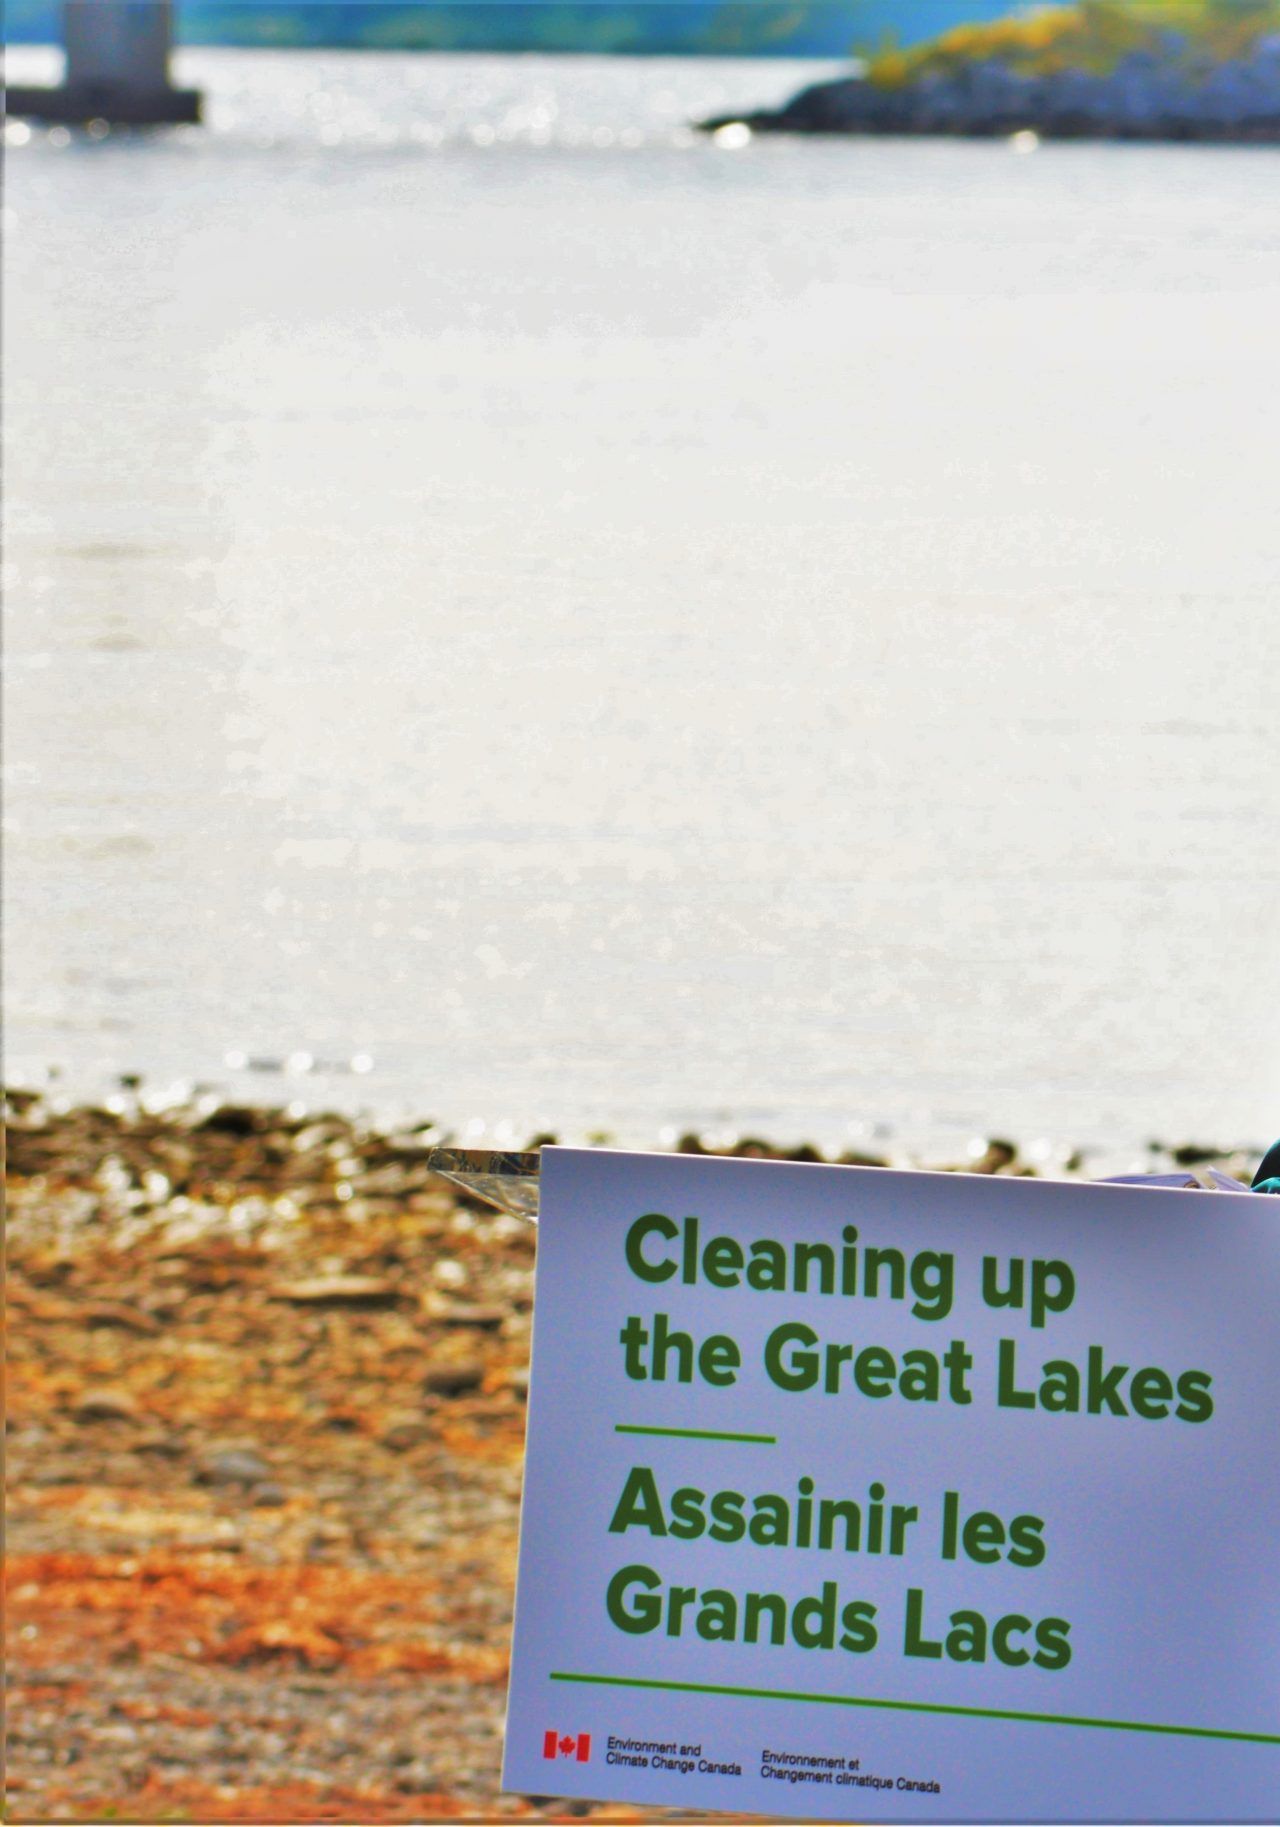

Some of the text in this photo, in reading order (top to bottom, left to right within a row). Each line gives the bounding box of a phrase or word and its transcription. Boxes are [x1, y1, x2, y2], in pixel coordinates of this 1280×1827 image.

[623, 1213, 1076, 1329] Cleaning up
[619, 1312, 1214, 1423] the Great Lakes
[608, 1466, 1046, 1567] Assainir les
[606, 1564, 1073, 1670] Grands Lacs
[606, 1752, 742, 1775] Climate Change Canada
[607, 1736, 701, 1756] Environment and
[762, 1750, 860, 1770] Environnement et
[761, 1766, 941, 1793] Changement climatique Canada
